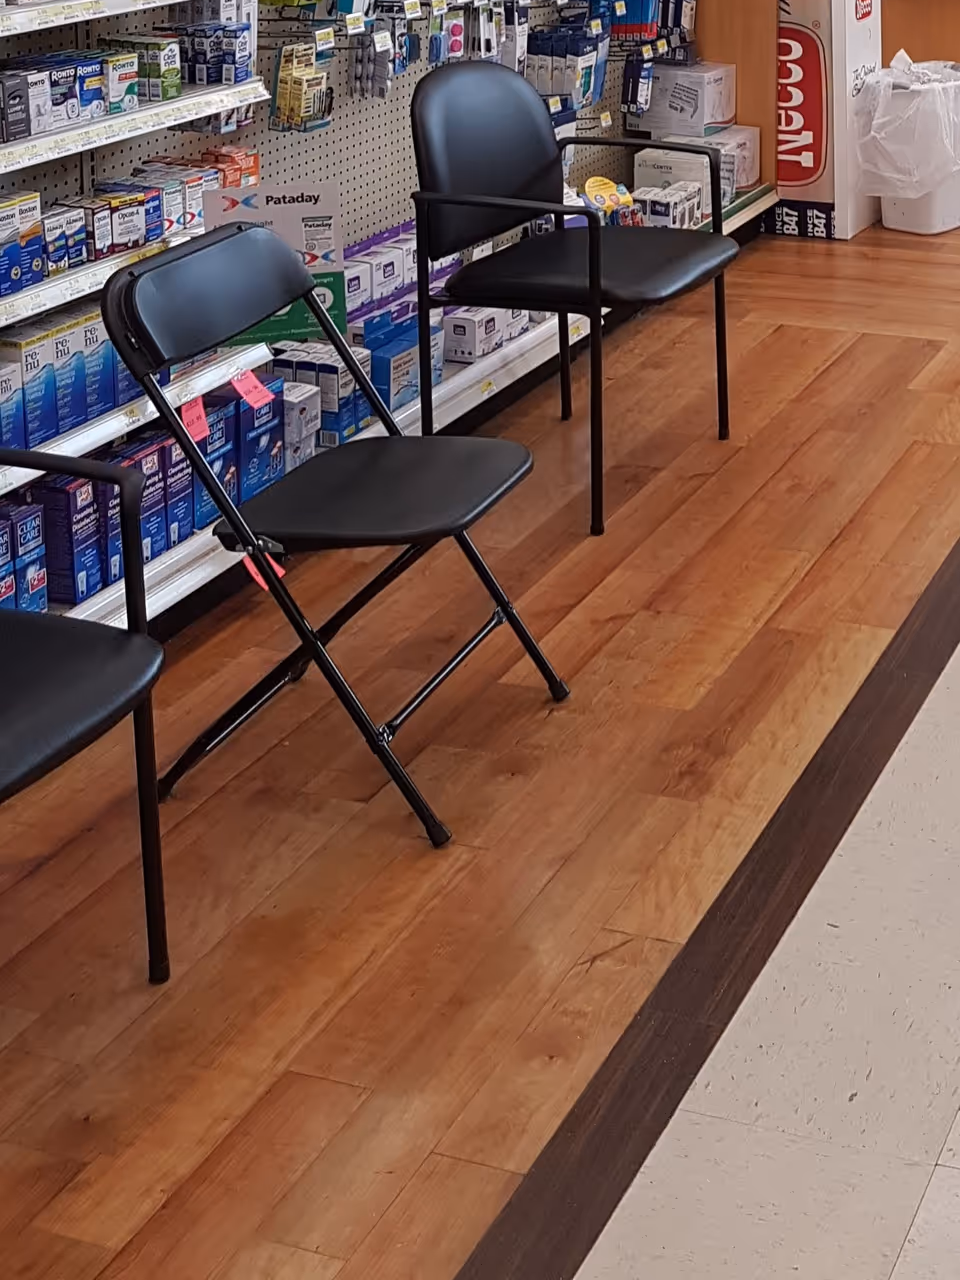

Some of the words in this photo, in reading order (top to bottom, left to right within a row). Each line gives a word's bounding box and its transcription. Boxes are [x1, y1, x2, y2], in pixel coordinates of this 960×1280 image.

[77, 64, 101, 77] ROHTO
[111, 61, 135, 73] ROHTO
[51, 68, 76, 82] ROHTO
[777, 38, 814, 168] Necco
[265, 192, 321, 206] Pataday
[18, 204, 38, 215] Boston
[304, 221, 332, 229] Pataday
[55, 348, 70, 359] nu
[25, 362, 40, 372] nu
[256, 405, 270, 417] CARE
[208, 429, 223, 443] CARE
[18, 517, 40, 536] CLEAR
[20, 526, 40, 544] CARE
